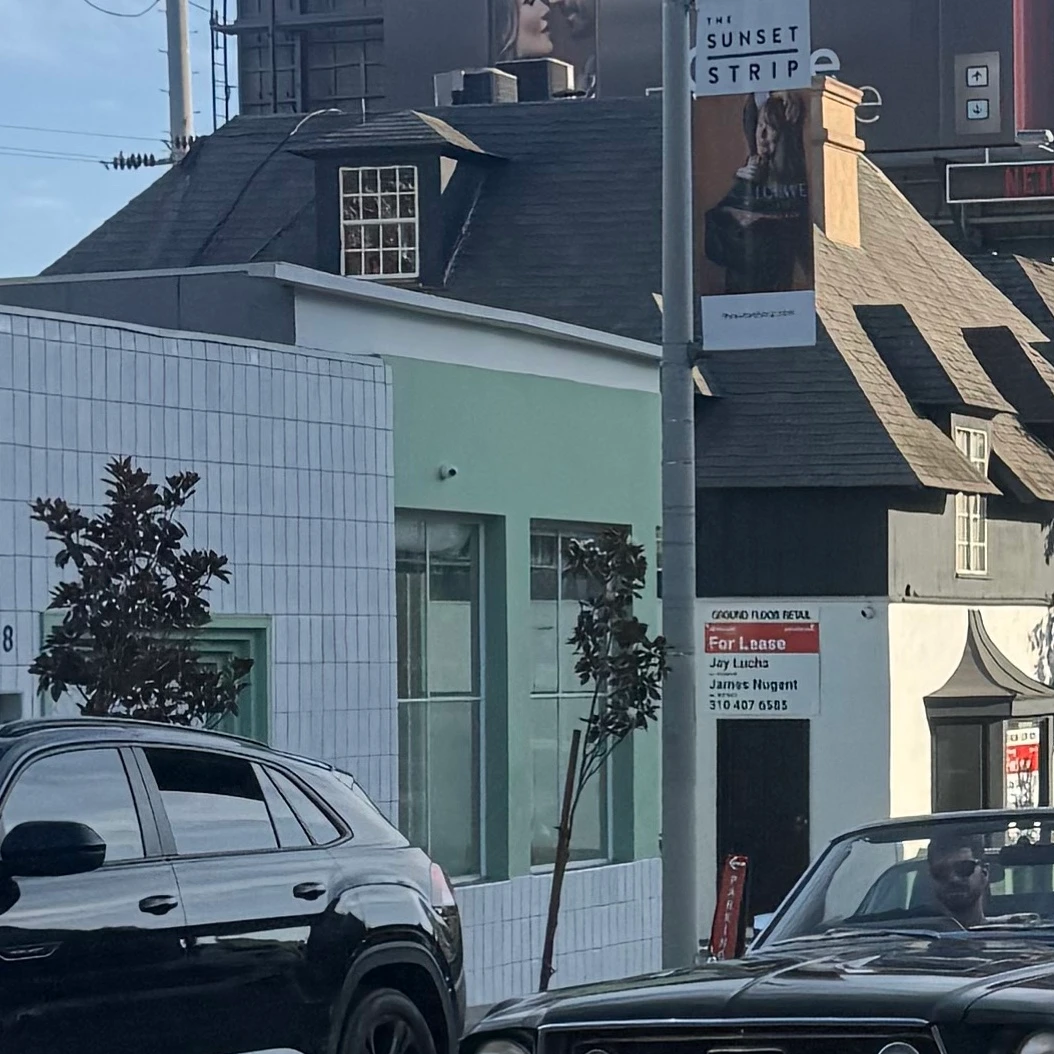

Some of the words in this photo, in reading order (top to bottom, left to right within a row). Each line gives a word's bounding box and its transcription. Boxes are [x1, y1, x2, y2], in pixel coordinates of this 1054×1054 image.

[707, 15, 732, 25] THE
[707, 26, 799, 49] SUNSET
[708, 60, 799, 84] STRIP
[3, 625, 13, 652] 8
[709, 636, 735, 651] For
[739, 636, 787, 651] Lease
[709, 657, 730, 671] Jay
[733, 656, 769, 668] Luchs
[709, 679, 749, 690] James
[753, 679, 798, 692] Nugent
[709, 700, 731, 711] 310
[733, 700, 755, 711] 407
